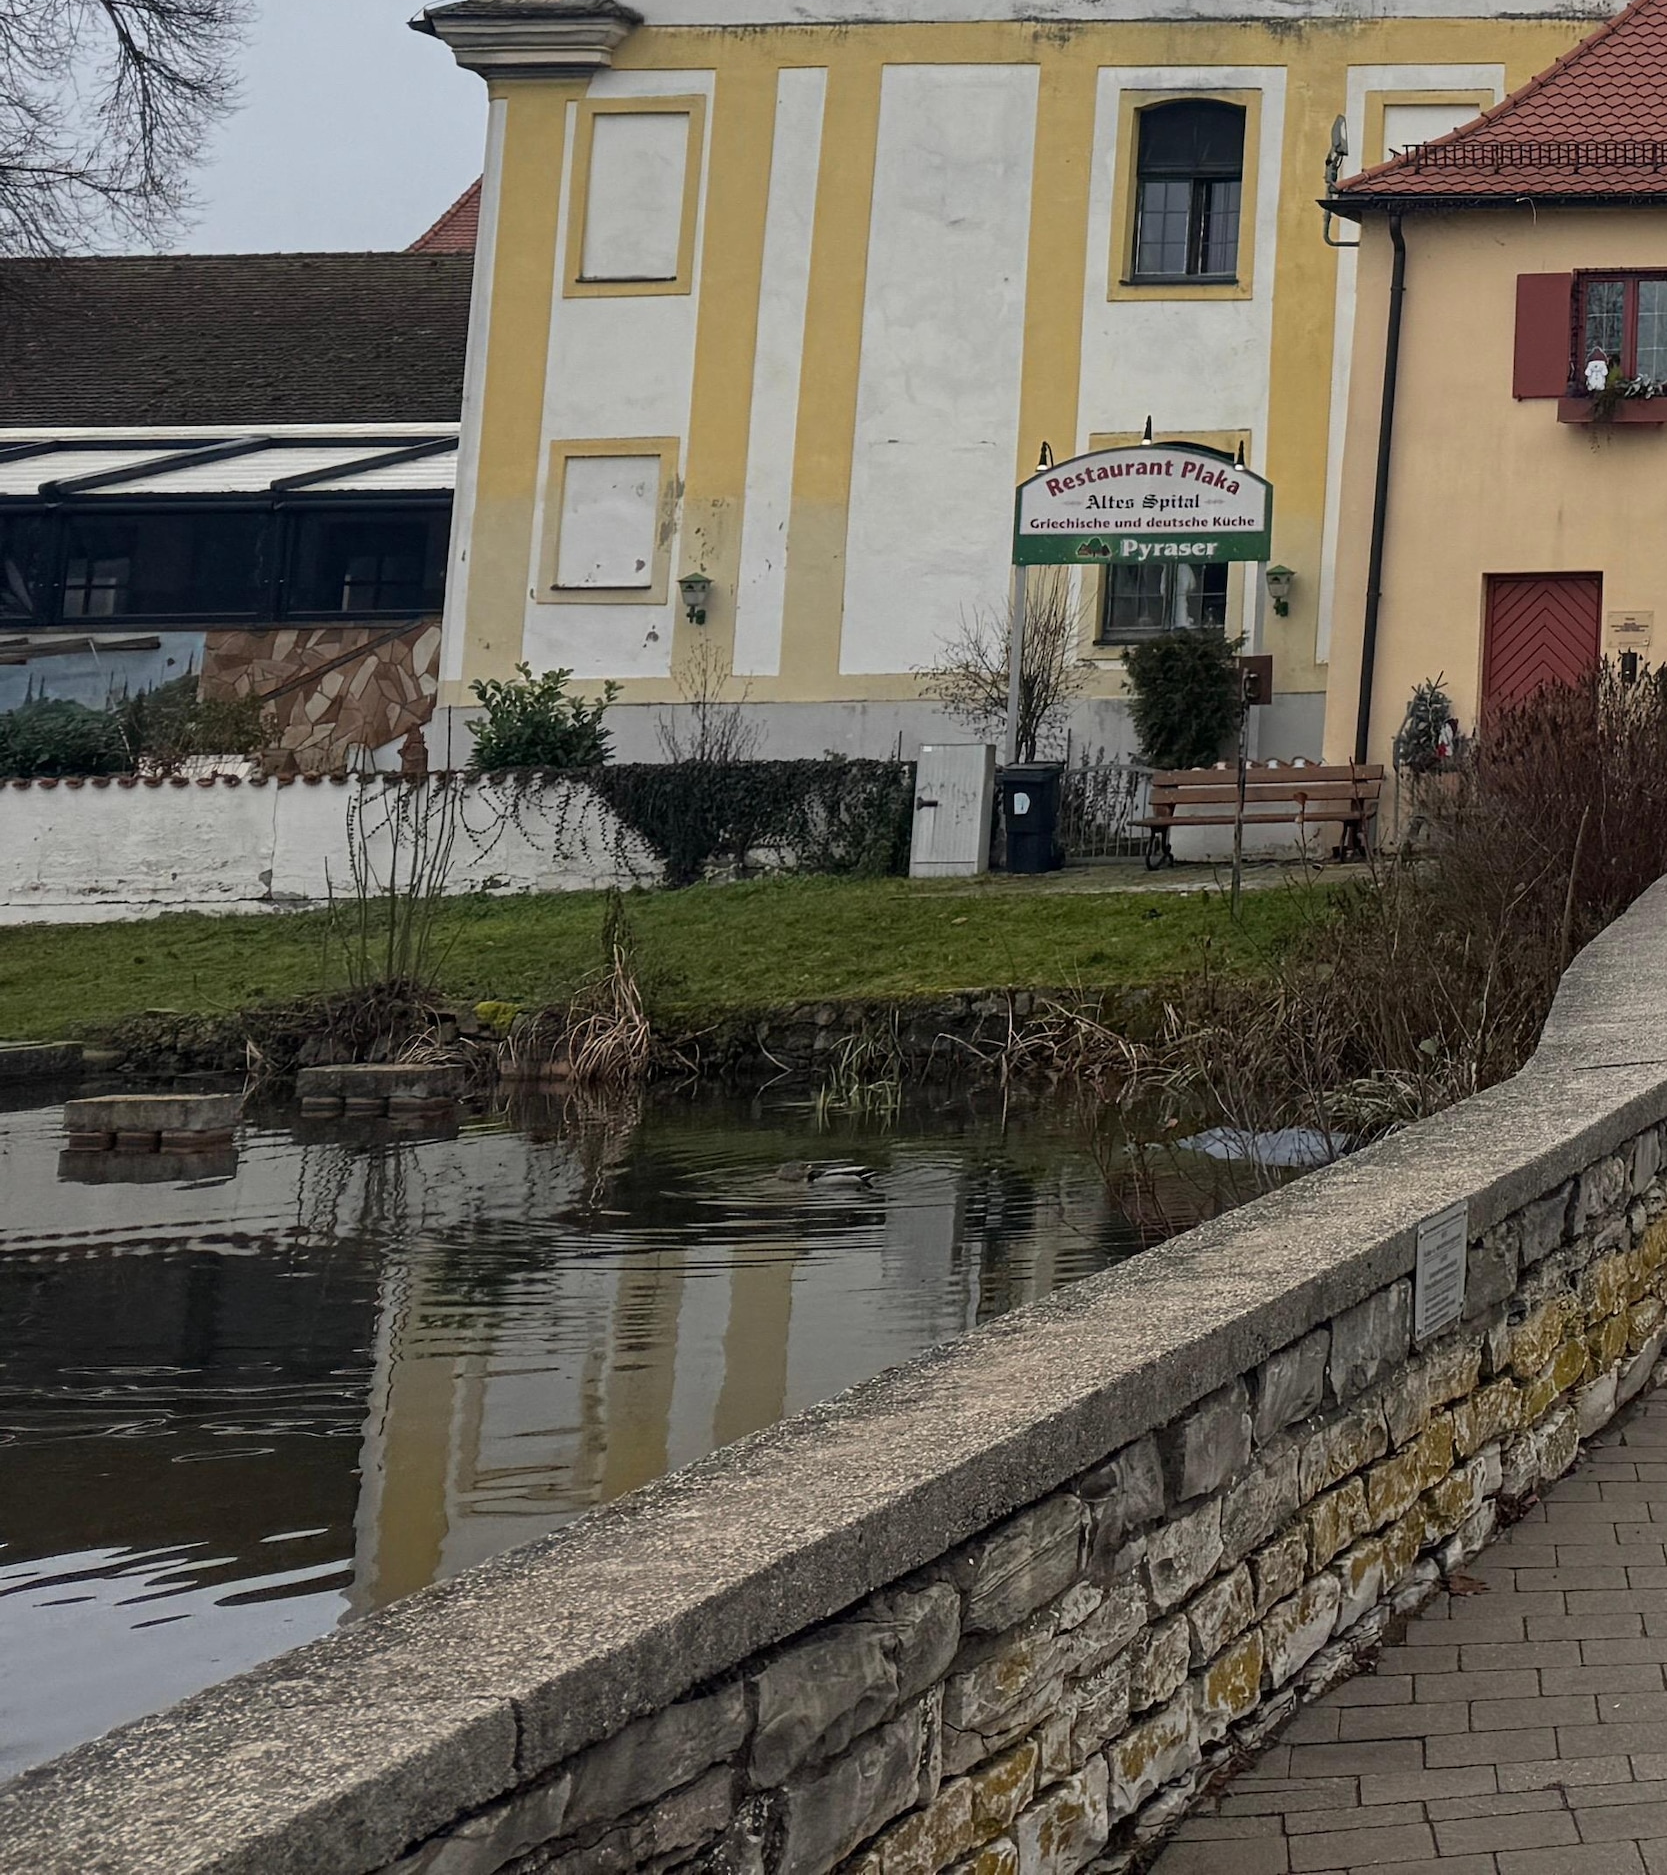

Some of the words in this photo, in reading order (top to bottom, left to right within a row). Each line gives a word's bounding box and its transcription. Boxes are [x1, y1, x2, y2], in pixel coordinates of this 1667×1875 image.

[1045, 460, 1174, 498] Restaurant
[1180, 460, 1241, 496] Plaka
[1085, 494, 1135, 511] Altes
[1142, 493, 1201, 512] Spital
[1030, 517, 1111, 529] Griechische
[1115, 517, 1142, 529] und
[1146, 516, 1208, 529] deutsche
[1213, 514, 1255, 528] Küche
[1119, 538, 1219, 561] Pyraser
